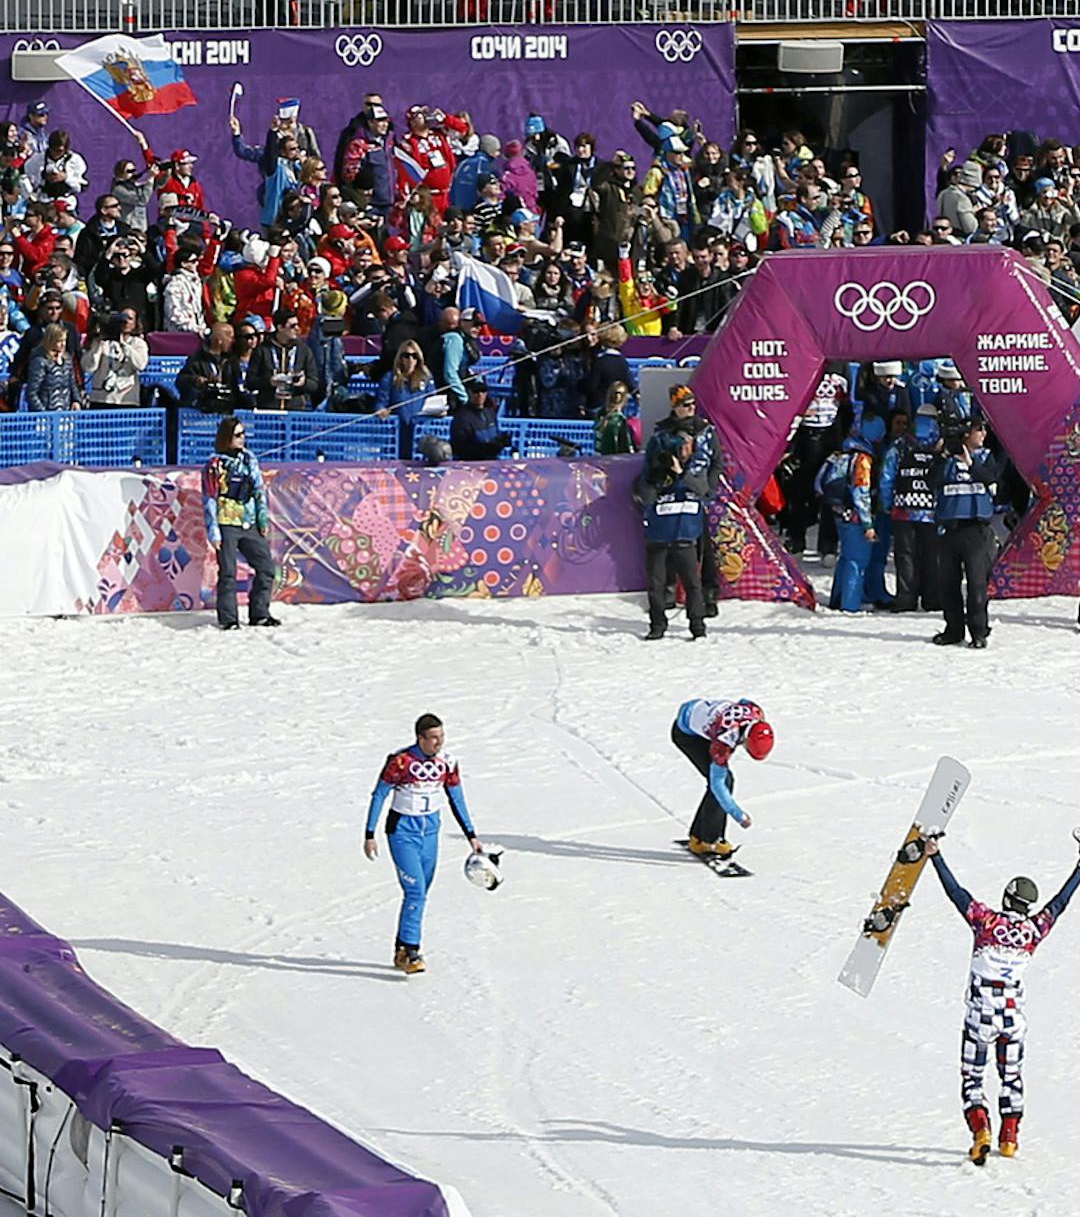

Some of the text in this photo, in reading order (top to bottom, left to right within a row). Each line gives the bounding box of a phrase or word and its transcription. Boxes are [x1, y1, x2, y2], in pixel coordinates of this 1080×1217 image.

[166, 40, 249, 65] CHI 2014
[471, 35, 567, 59] СОЧИ 2014
[751, 340, 788, 356] HOT.
[977, 333, 1054, 350] ЖАРКИЕ.
[743, 362, 789, 379] COOL.
[978, 354, 1049, 372] ЗИМНИЕ.
[730, 384, 790, 401] YOURS.
[978, 377, 1028, 394] ТВОИ.
[419, 796, 431, 813] 1
